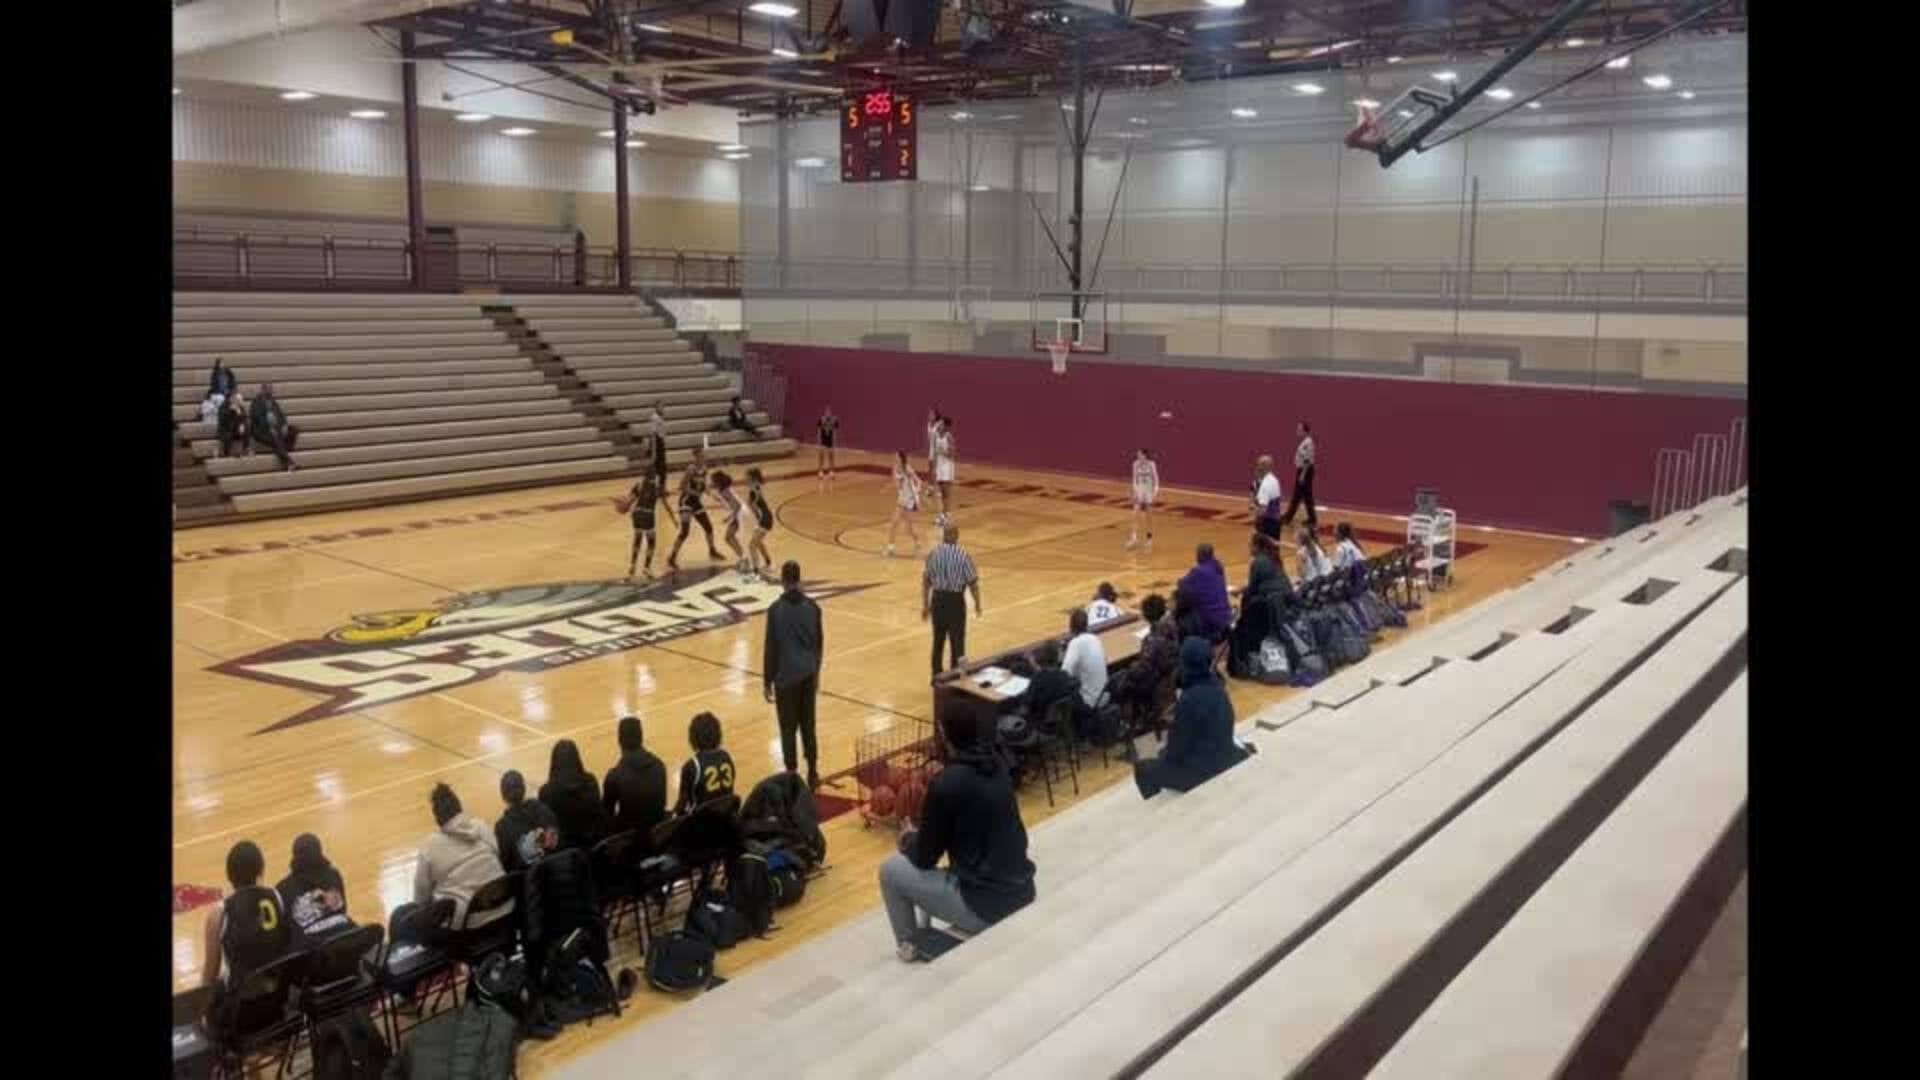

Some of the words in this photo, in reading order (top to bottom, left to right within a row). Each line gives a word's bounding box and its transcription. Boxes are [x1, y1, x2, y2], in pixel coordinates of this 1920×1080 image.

[848, 105, 859, 128] 5
[900, 102, 911, 125] 5
[238, 567, 830, 713] EAGLES
[704, 763, 733, 793] 23
